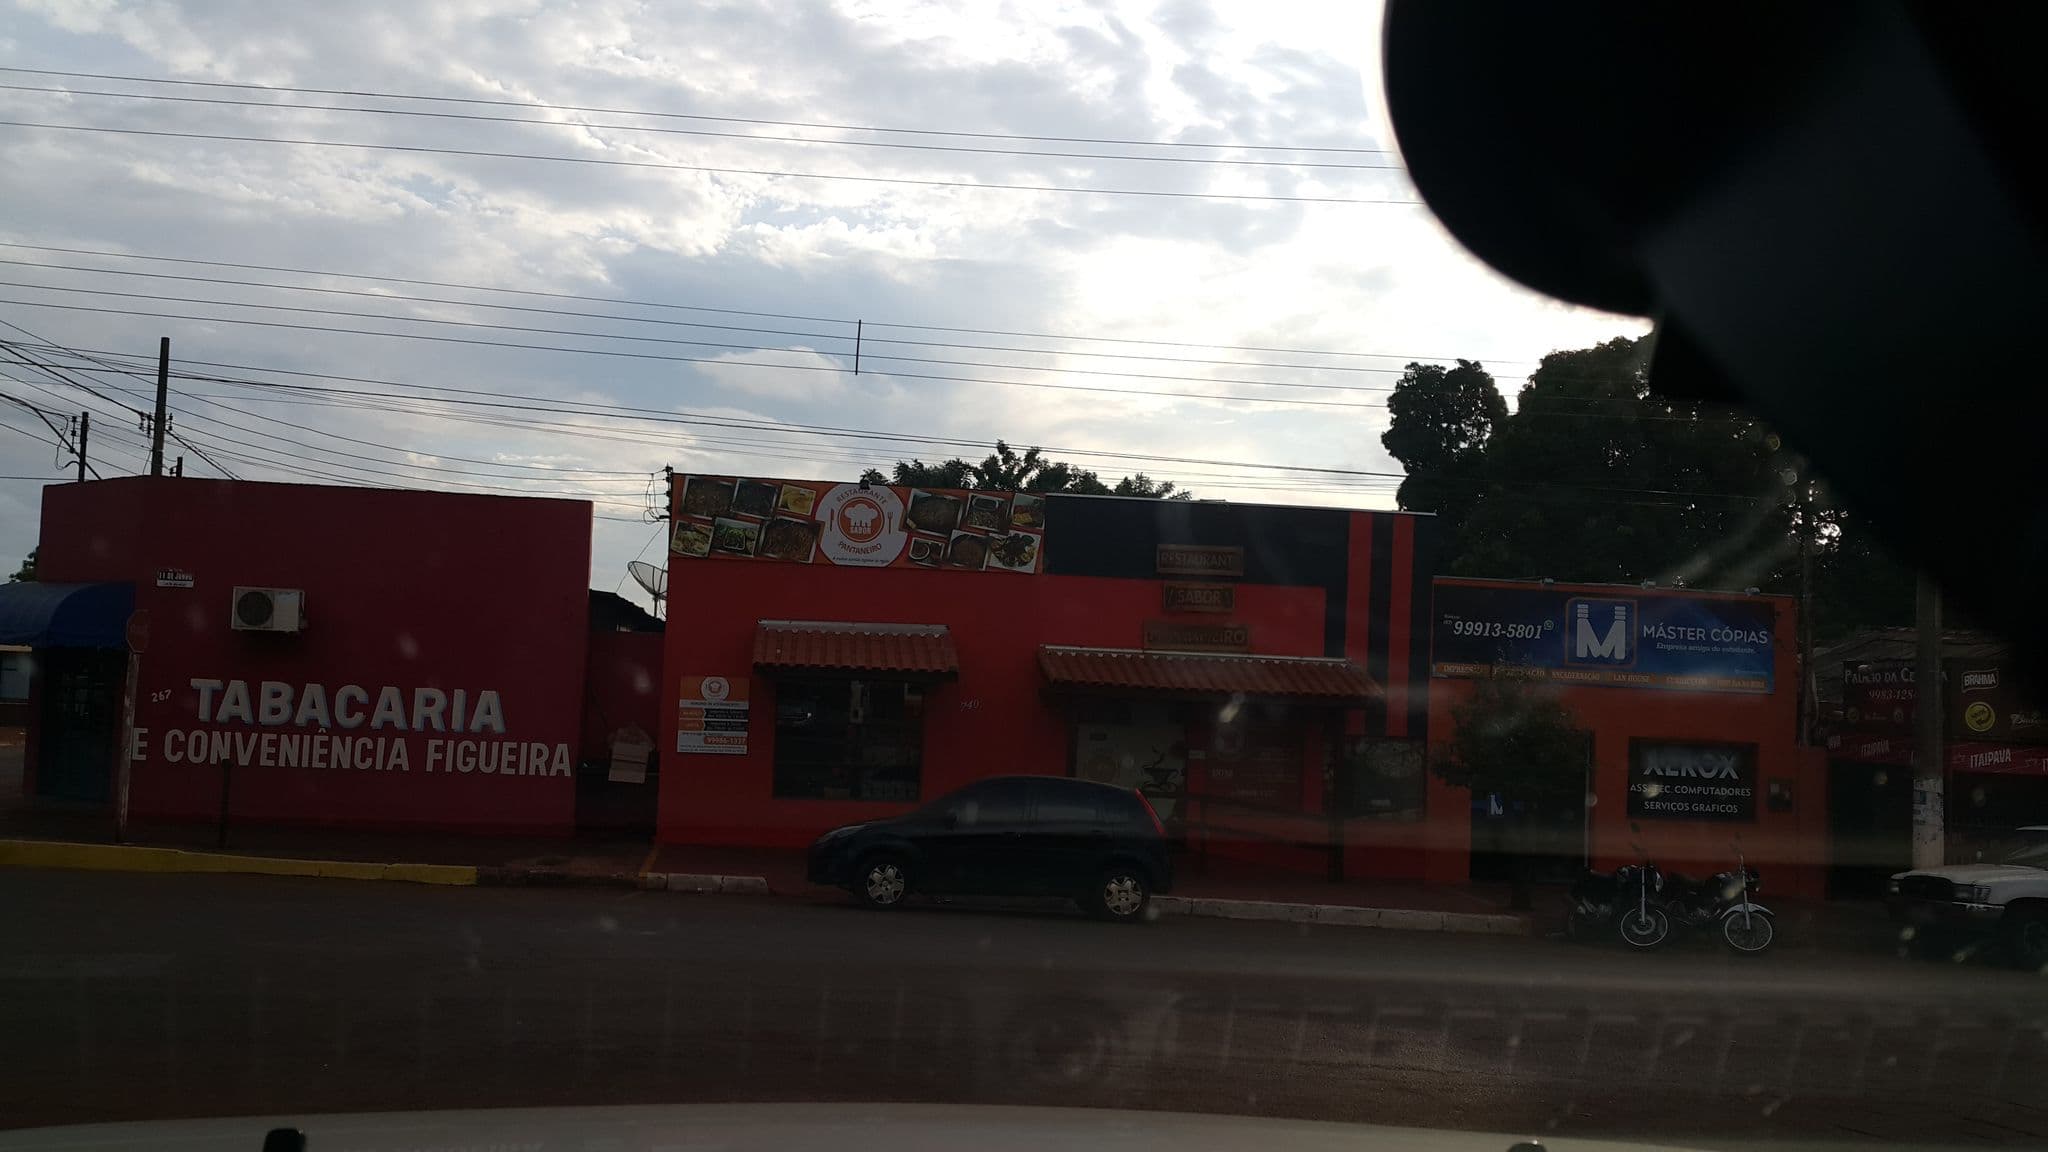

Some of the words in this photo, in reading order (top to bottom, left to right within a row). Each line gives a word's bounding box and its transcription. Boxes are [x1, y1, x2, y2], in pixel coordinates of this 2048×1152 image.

[838, 541, 882, 555] PANTANEIRO
[1453, 621, 1543, 640] 99913-5801
[1643, 622, 1707, 642] MÁSTER
[1711, 625, 1769, 645] CÓPIAS
[1964, 673, 1996, 687] BRAHMA
[151, 689, 172, 704] 267
[190, 677, 505, 734] TABACARIA
[163, 728, 410, 773] CONVENIÊNCIA
[426, 738, 573, 778] FIGUEIRA
[1970, 747, 2013, 769] ITAIPAVA
[1643, 750, 1740, 780] XEROX
[1674, 785, 1752, 798] COMPUTADORES
[1644, 800, 1690, 813] SERVIÇOS
